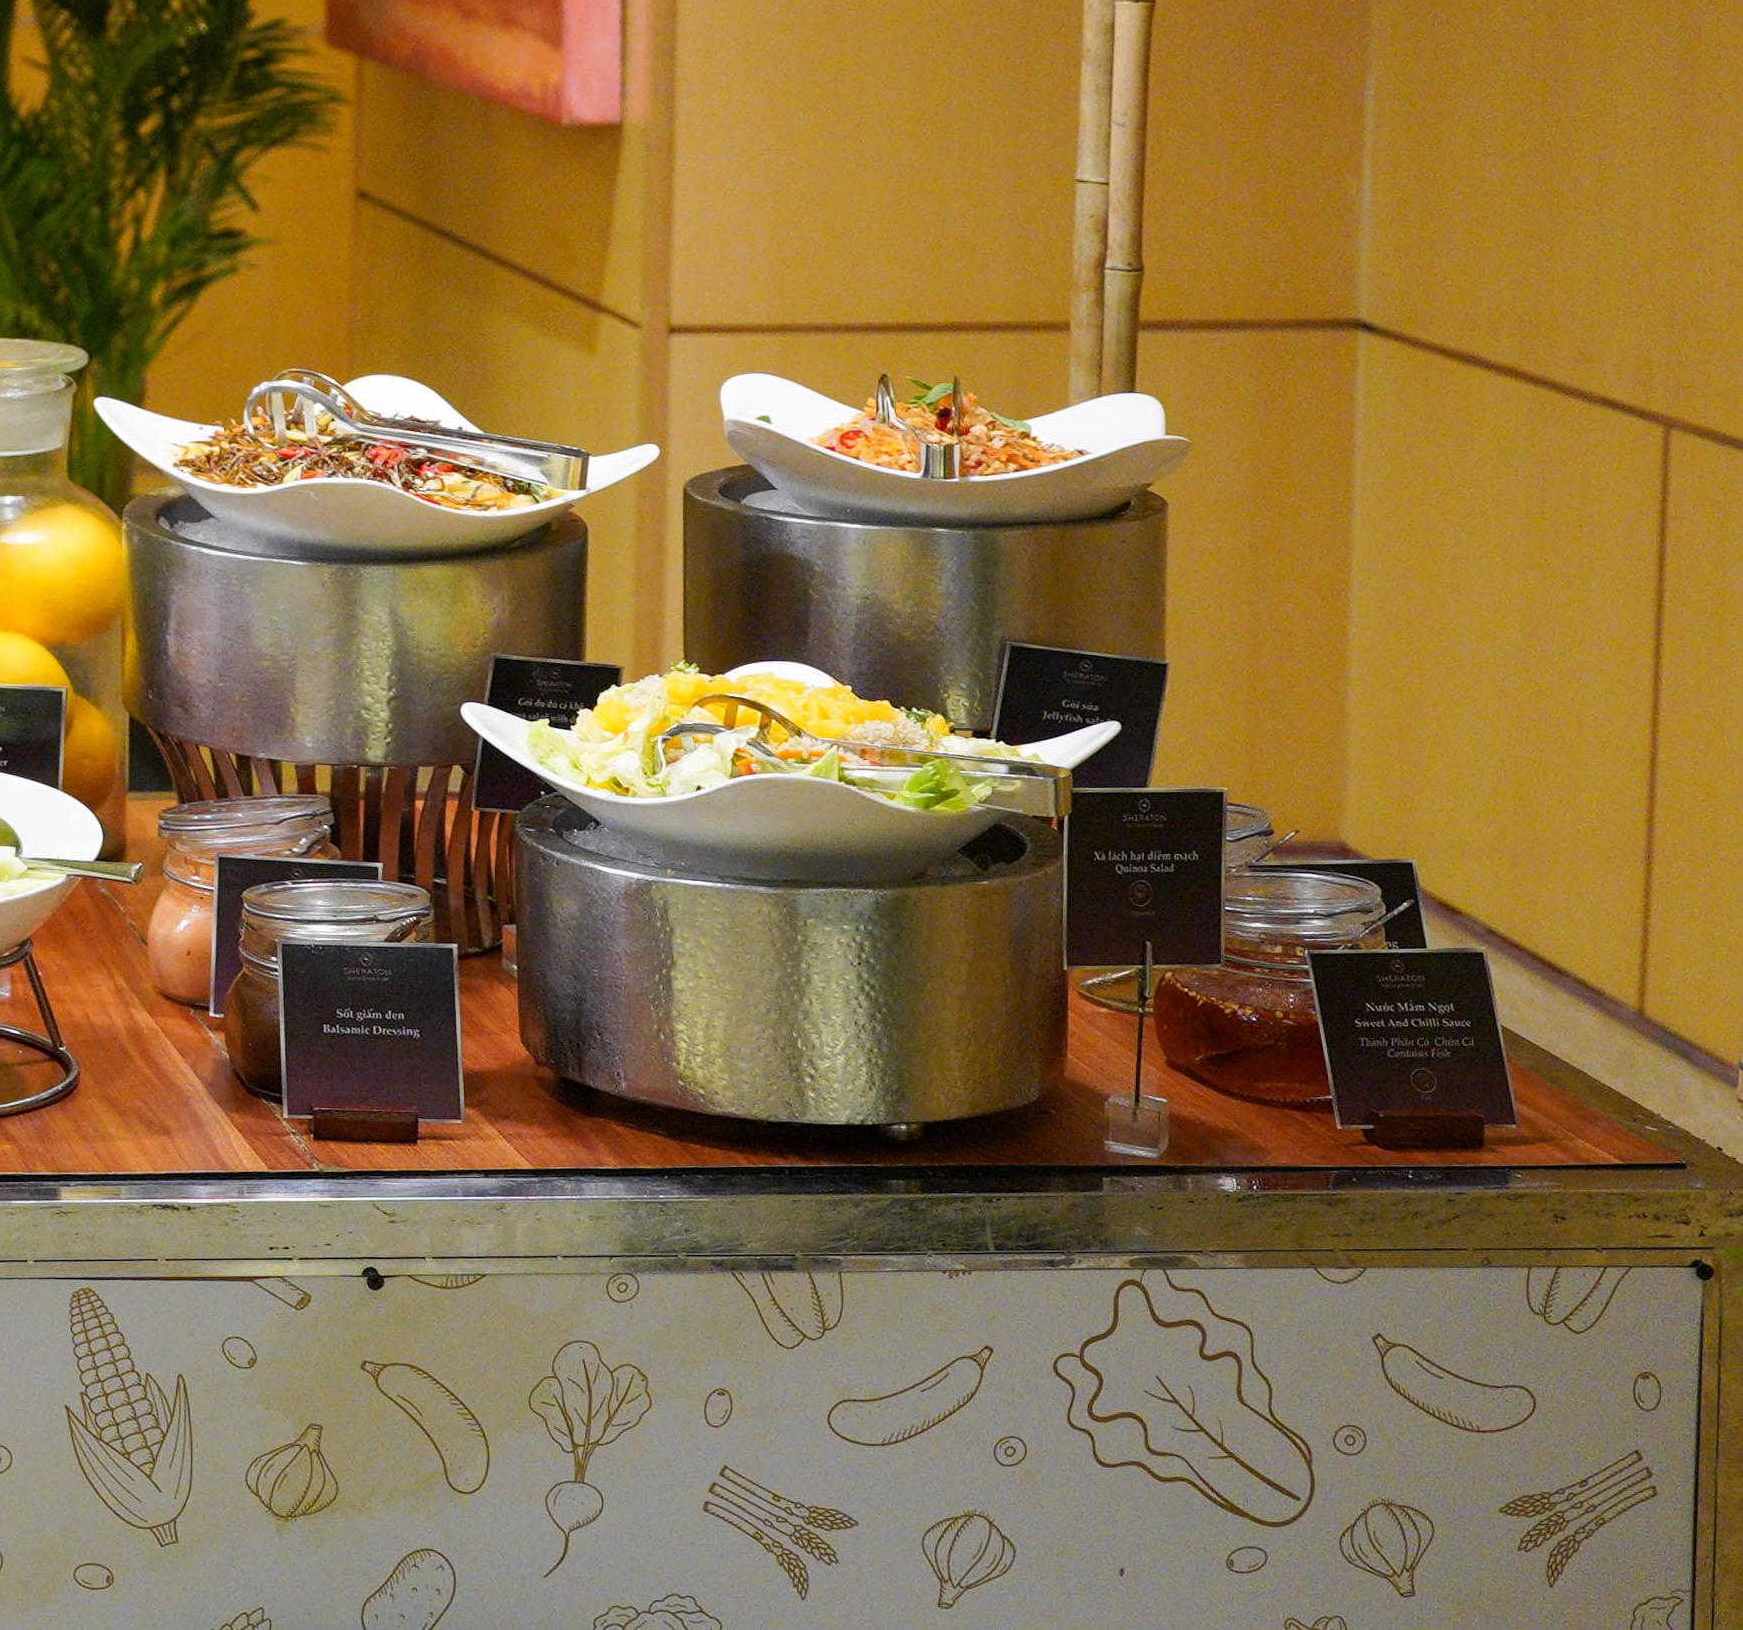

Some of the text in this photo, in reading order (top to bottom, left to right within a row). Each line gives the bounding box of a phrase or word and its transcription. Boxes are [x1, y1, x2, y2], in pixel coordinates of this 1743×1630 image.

[1042, 711, 1083, 723] Jellyfish
[1150, 864, 1175, 873] Salad
[336, 1007, 354, 1020] Sốt
[1354, 1018, 1471, 1028] Sweet And Chilli Sauce
[323, 1023, 420, 1039] Balsamic Dressing
